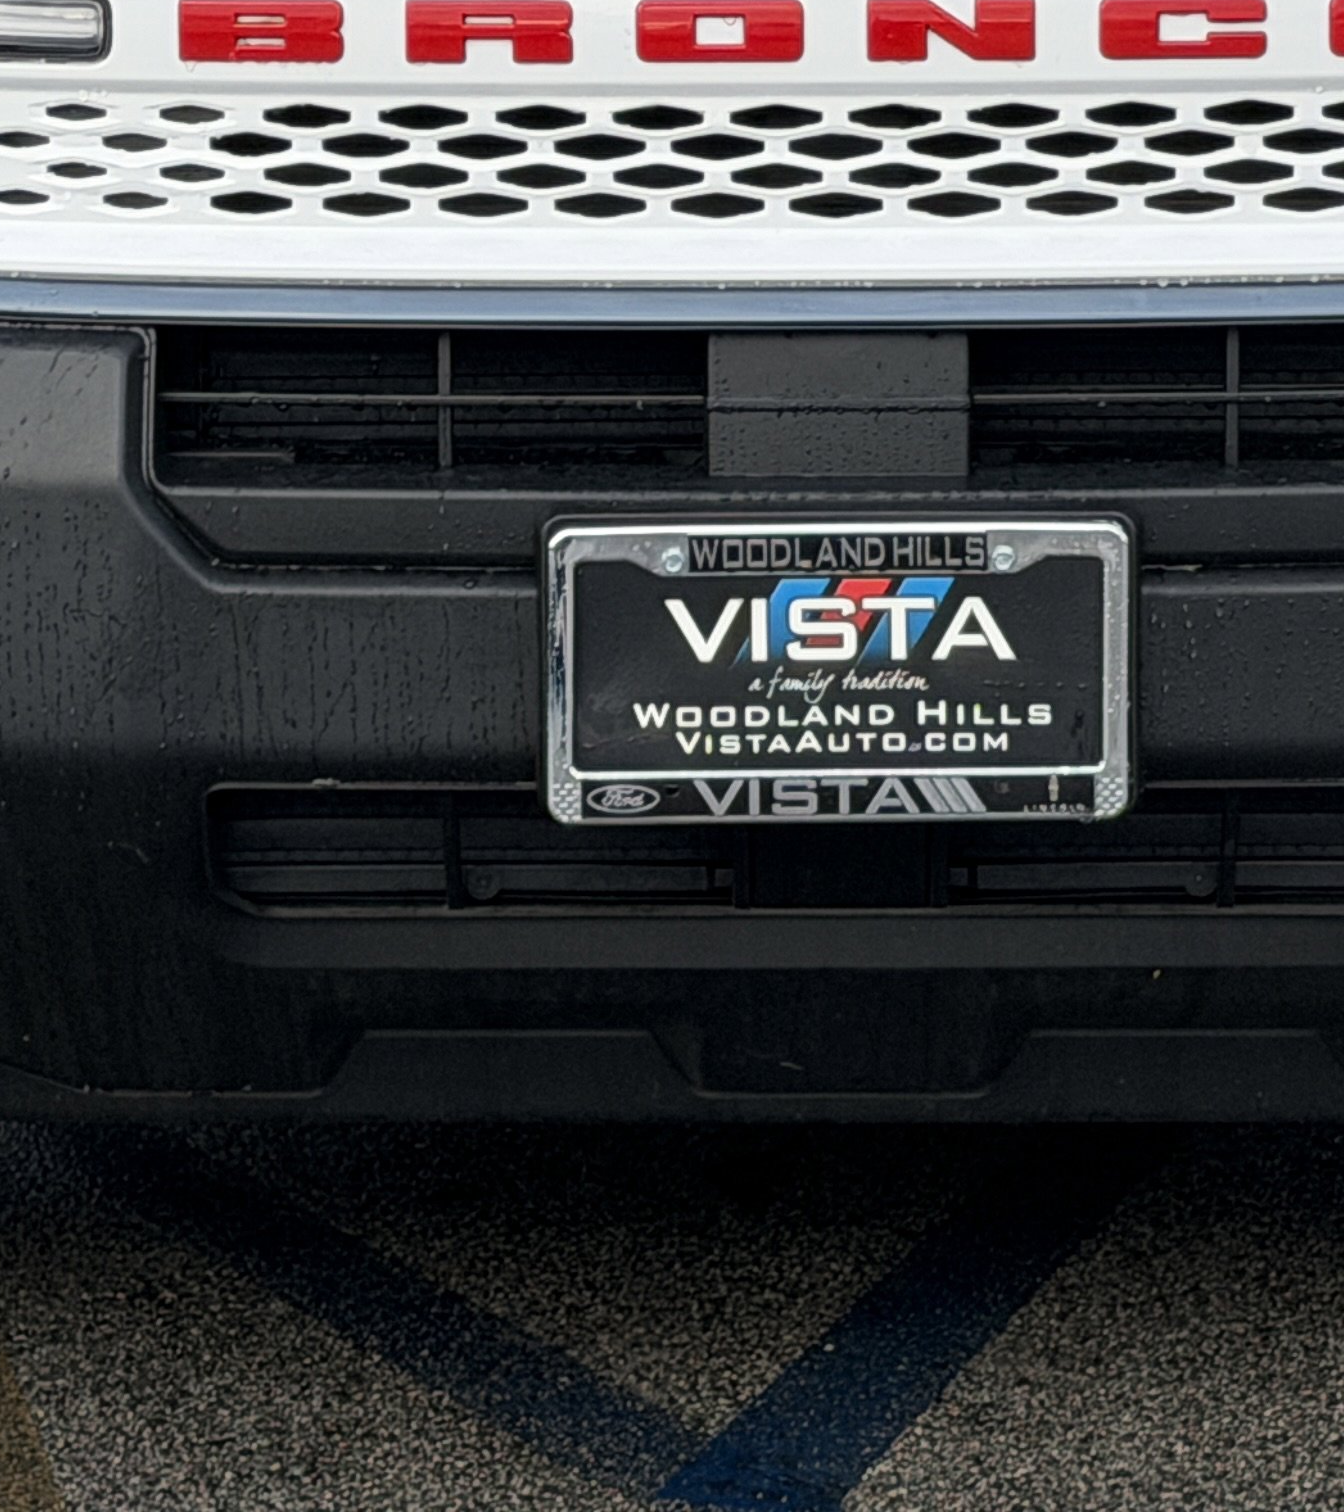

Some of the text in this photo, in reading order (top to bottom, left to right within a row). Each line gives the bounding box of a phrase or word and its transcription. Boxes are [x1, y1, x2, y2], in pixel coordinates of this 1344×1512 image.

[692, 536, 984, 569] WOODLAND HILLS
[664, 596, 1017, 663] VISTA
[748, 665, 929, 704] a family tradition
[693, 778, 920, 816] VISTA
